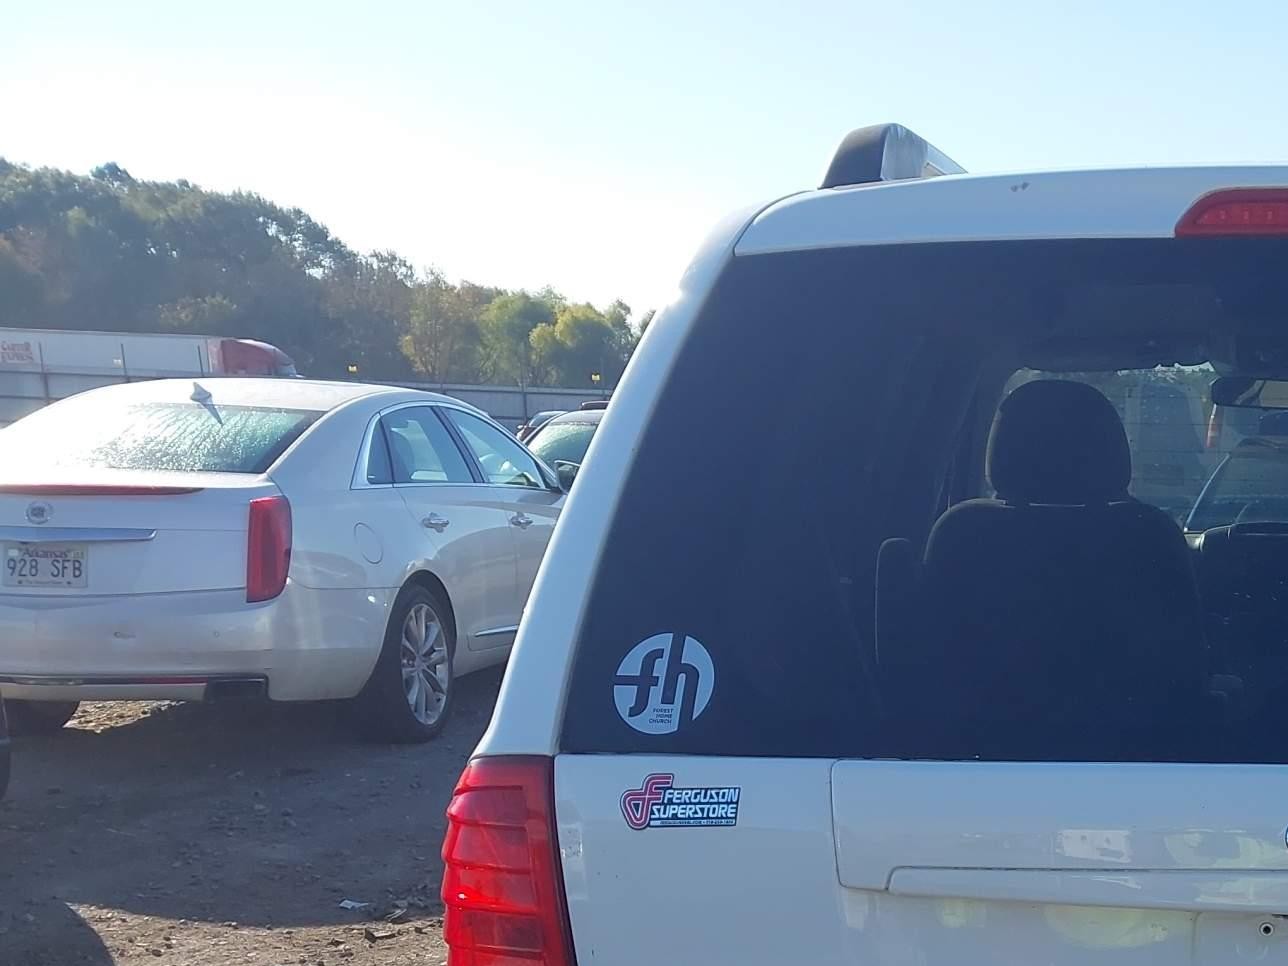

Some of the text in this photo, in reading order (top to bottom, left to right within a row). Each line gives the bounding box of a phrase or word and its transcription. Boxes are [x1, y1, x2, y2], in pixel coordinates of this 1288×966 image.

[7, 558, 82, 578] 928 SFB
[663, 789, 739, 803] FERGUSON
[650, 804, 737, 818] SUPERSTORE
